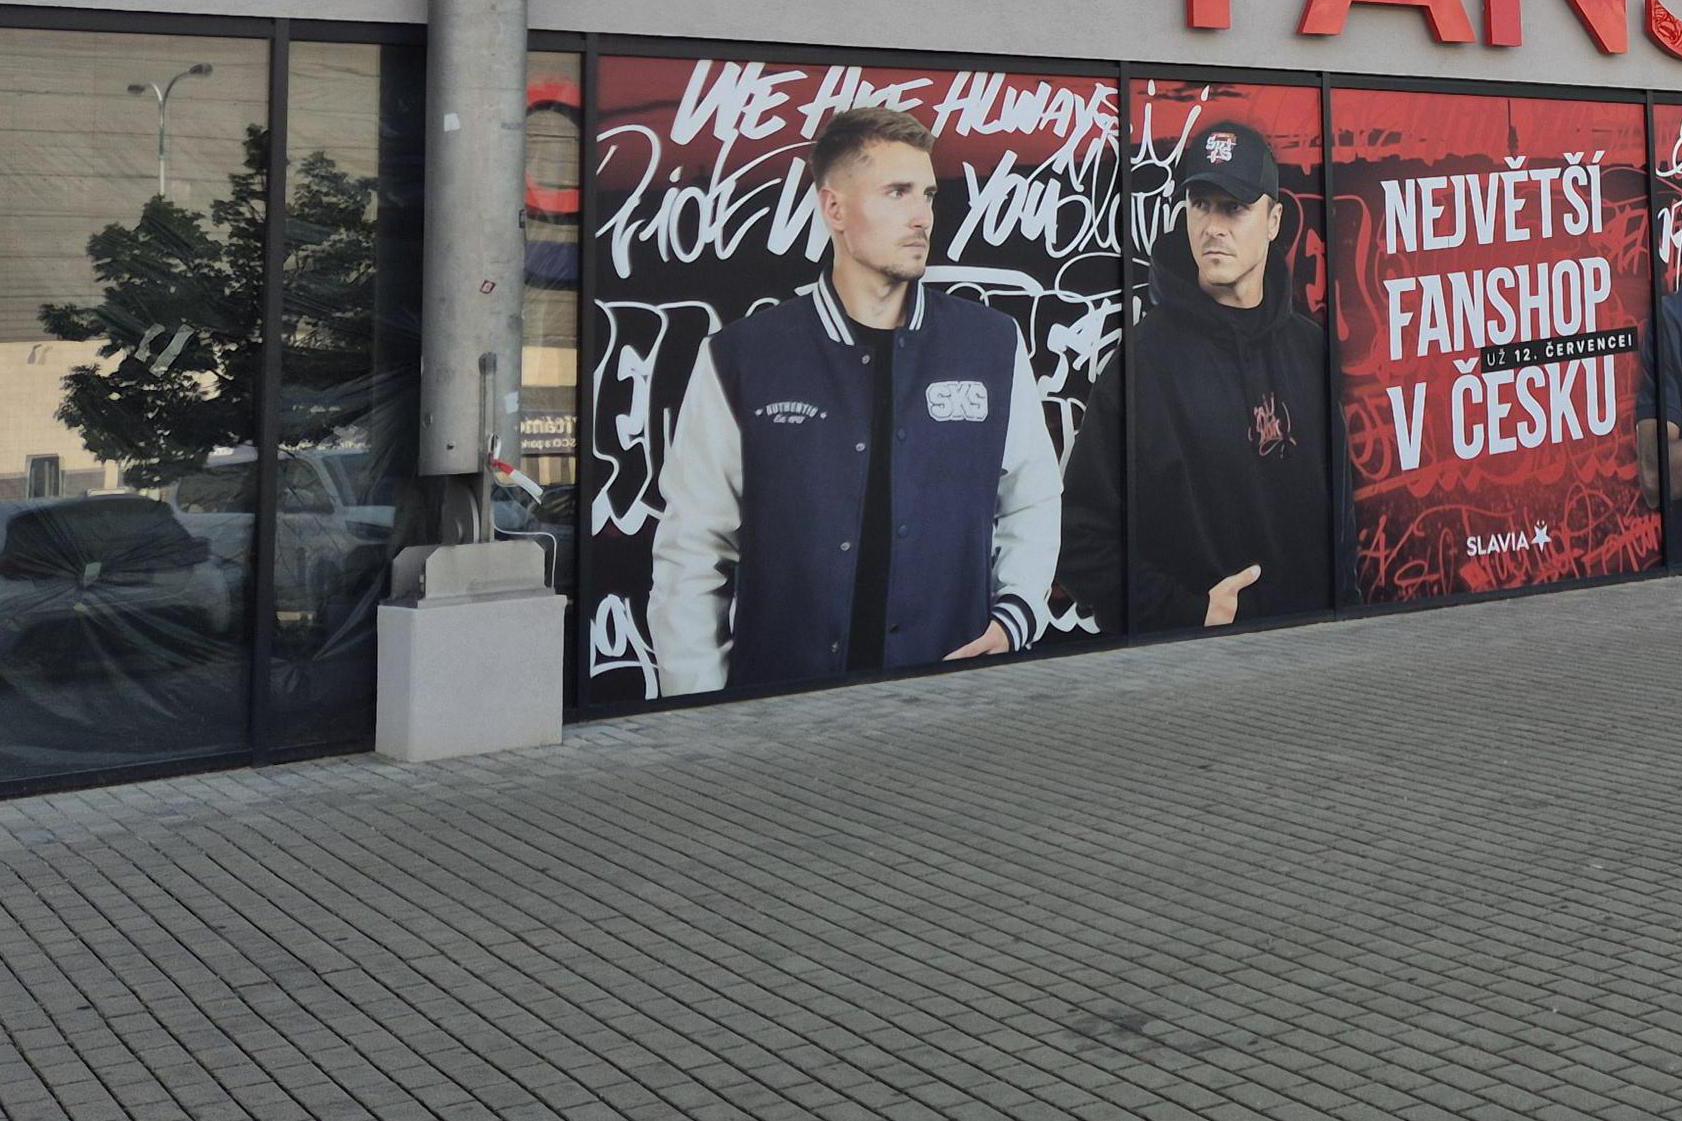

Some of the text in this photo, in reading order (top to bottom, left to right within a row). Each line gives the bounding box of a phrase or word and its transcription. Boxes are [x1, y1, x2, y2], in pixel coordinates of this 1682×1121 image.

[670, 60, 806, 145] WE
[1380, 150, 1606, 255] NEJVĚTŠÍ
[1383, 256, 1612, 360] FANSHOP
[1486, 348, 1506, 367] UŽ
[1514, 348, 1538, 363] 12.
[926, 380, 988, 421] SKS
[1386, 382, 1427, 472] V
[1451, 355, 1617, 460] ČESKU
[1466, 531, 1530, 557] SLAVIA
